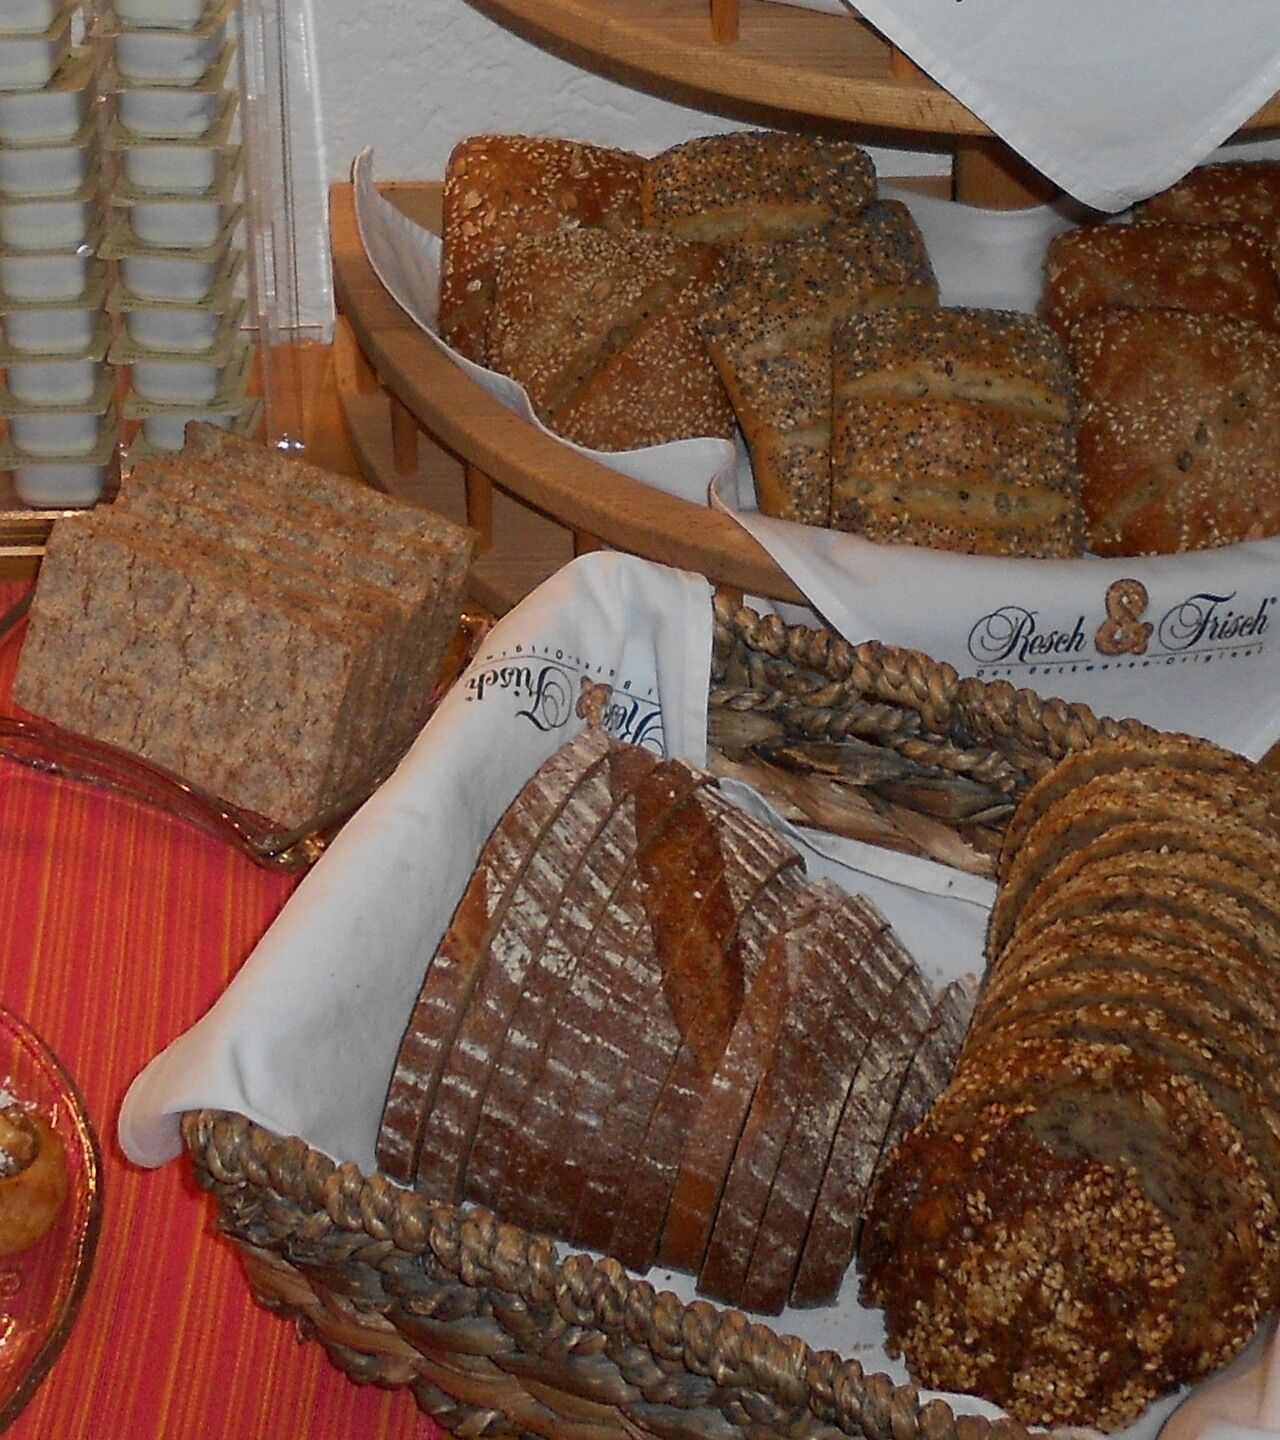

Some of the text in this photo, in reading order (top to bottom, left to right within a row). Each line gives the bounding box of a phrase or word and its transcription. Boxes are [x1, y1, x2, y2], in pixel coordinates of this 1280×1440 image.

[967, 577, 1270, 662] Resch & Frisch
